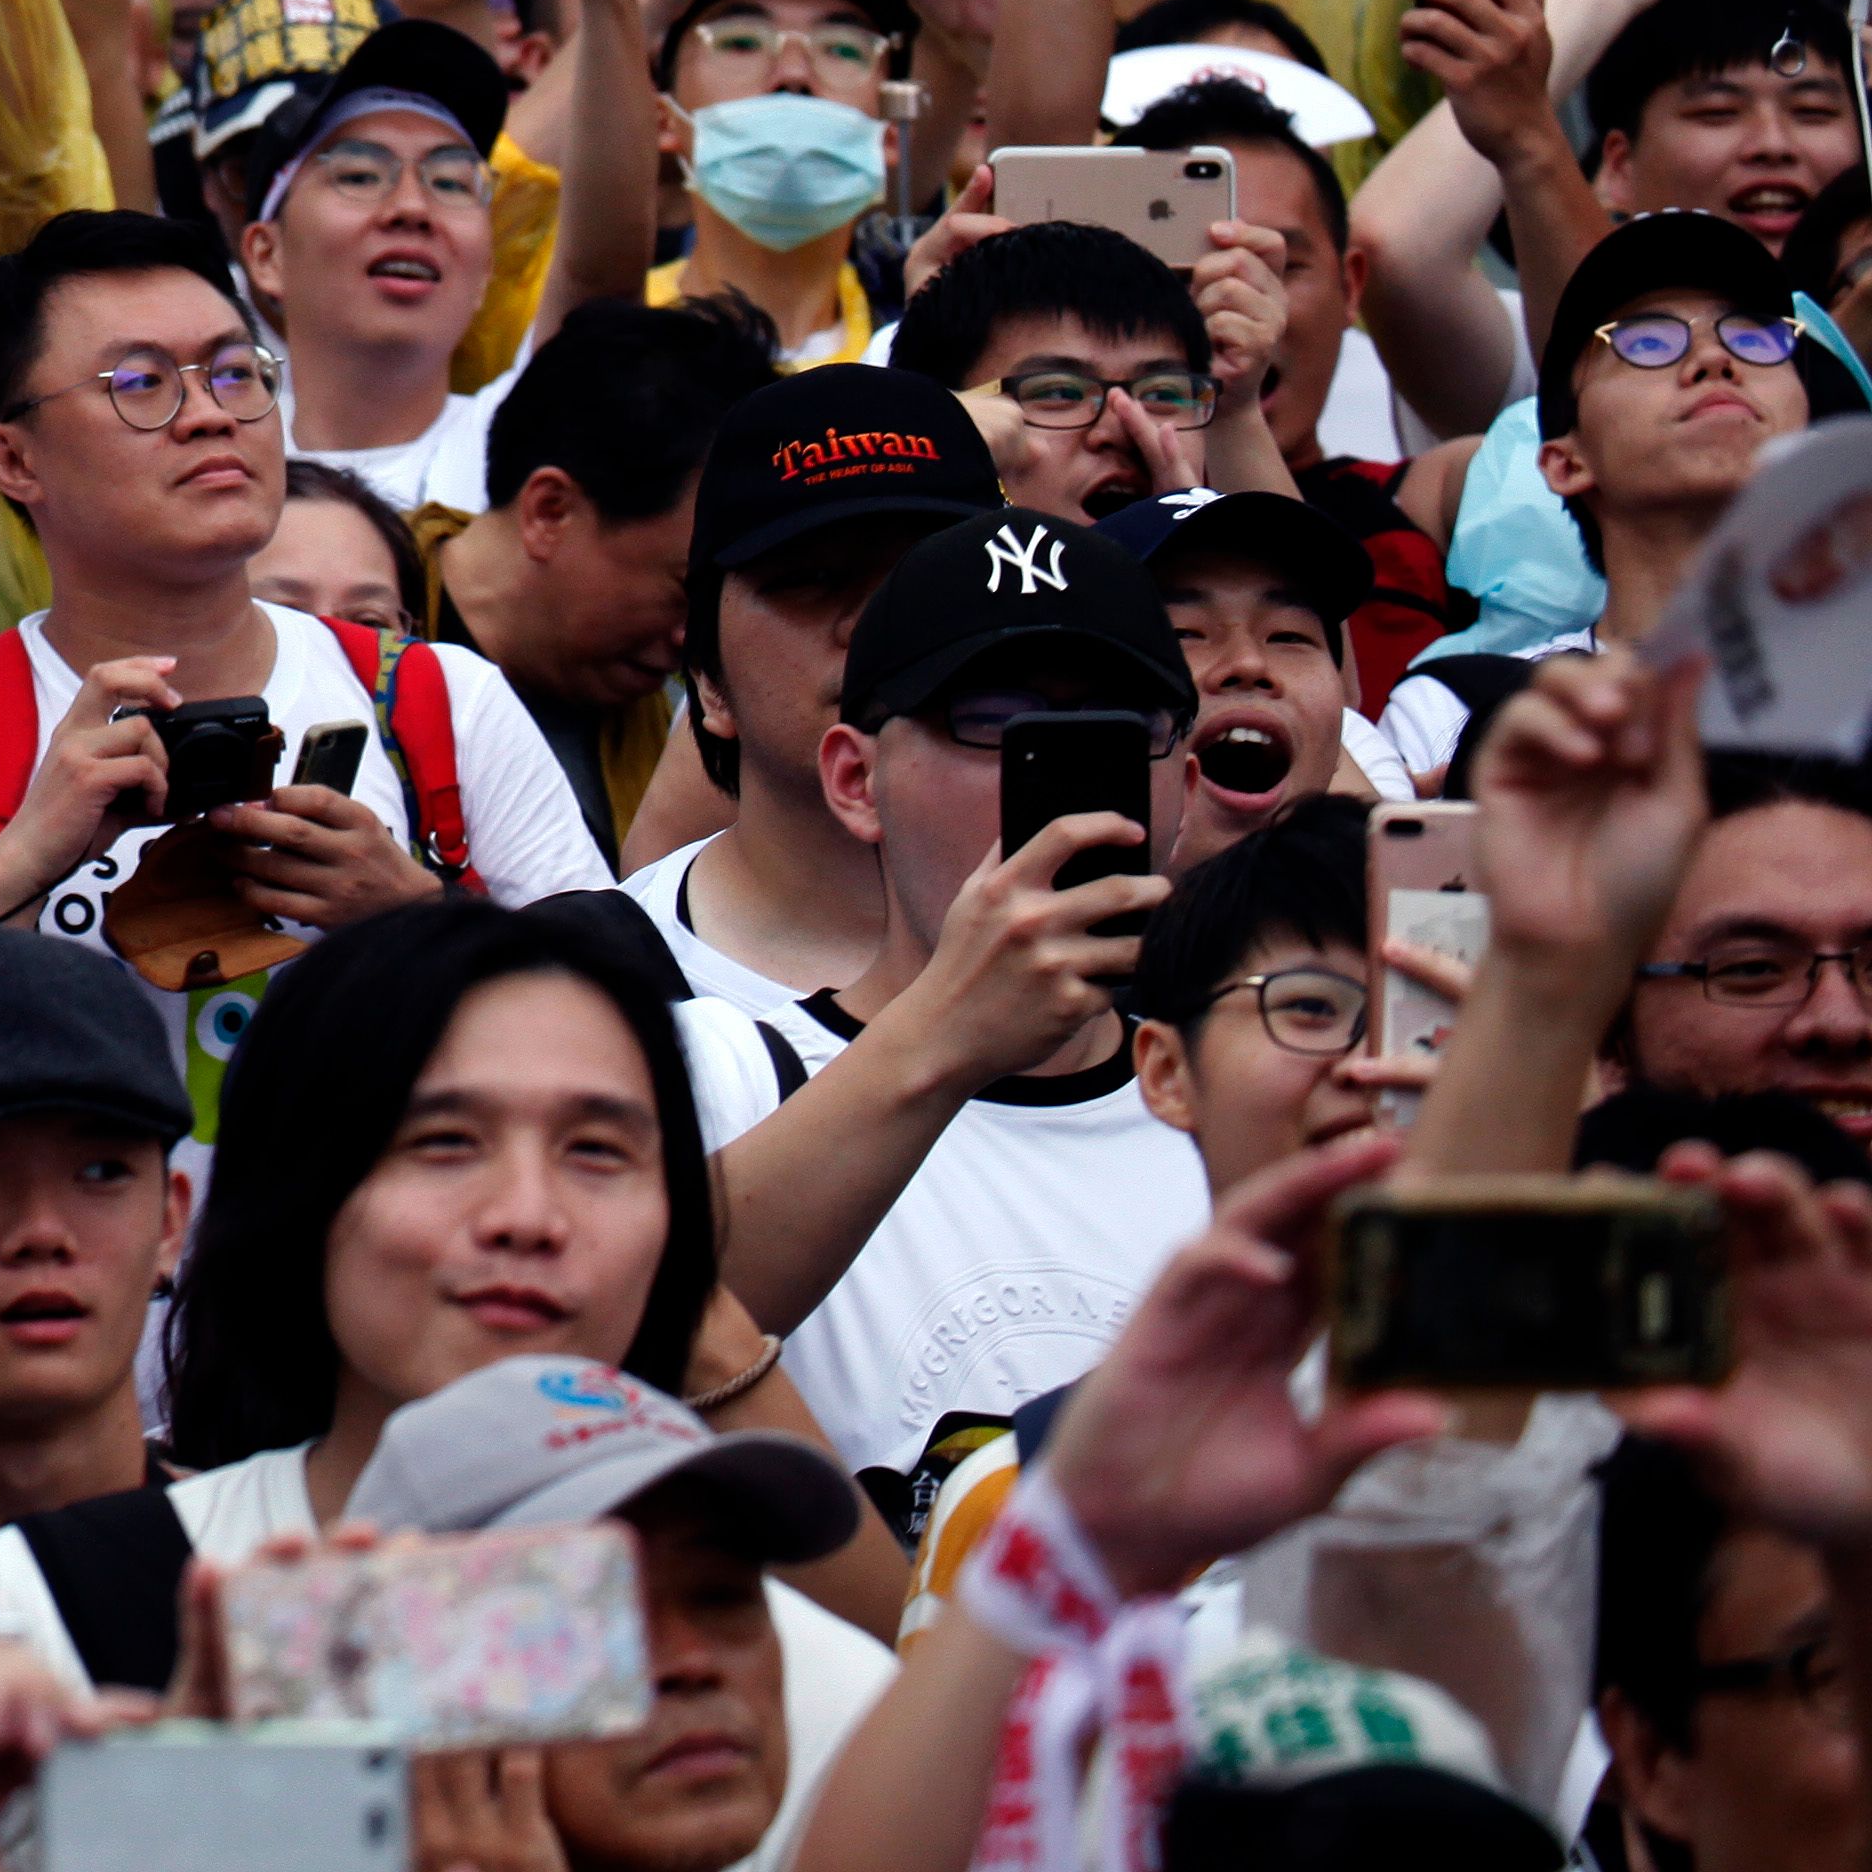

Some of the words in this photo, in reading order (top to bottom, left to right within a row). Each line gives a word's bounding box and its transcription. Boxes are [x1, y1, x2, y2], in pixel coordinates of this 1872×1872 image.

[772, 427, 942, 481] Taiwan
[803, 471, 827, 486] THE
[829, 464, 868, 480] HEART
[870, 463, 886, 474] OF
[887, 463, 914, 474] ASIA
[984, 523, 1071, 595] NY
